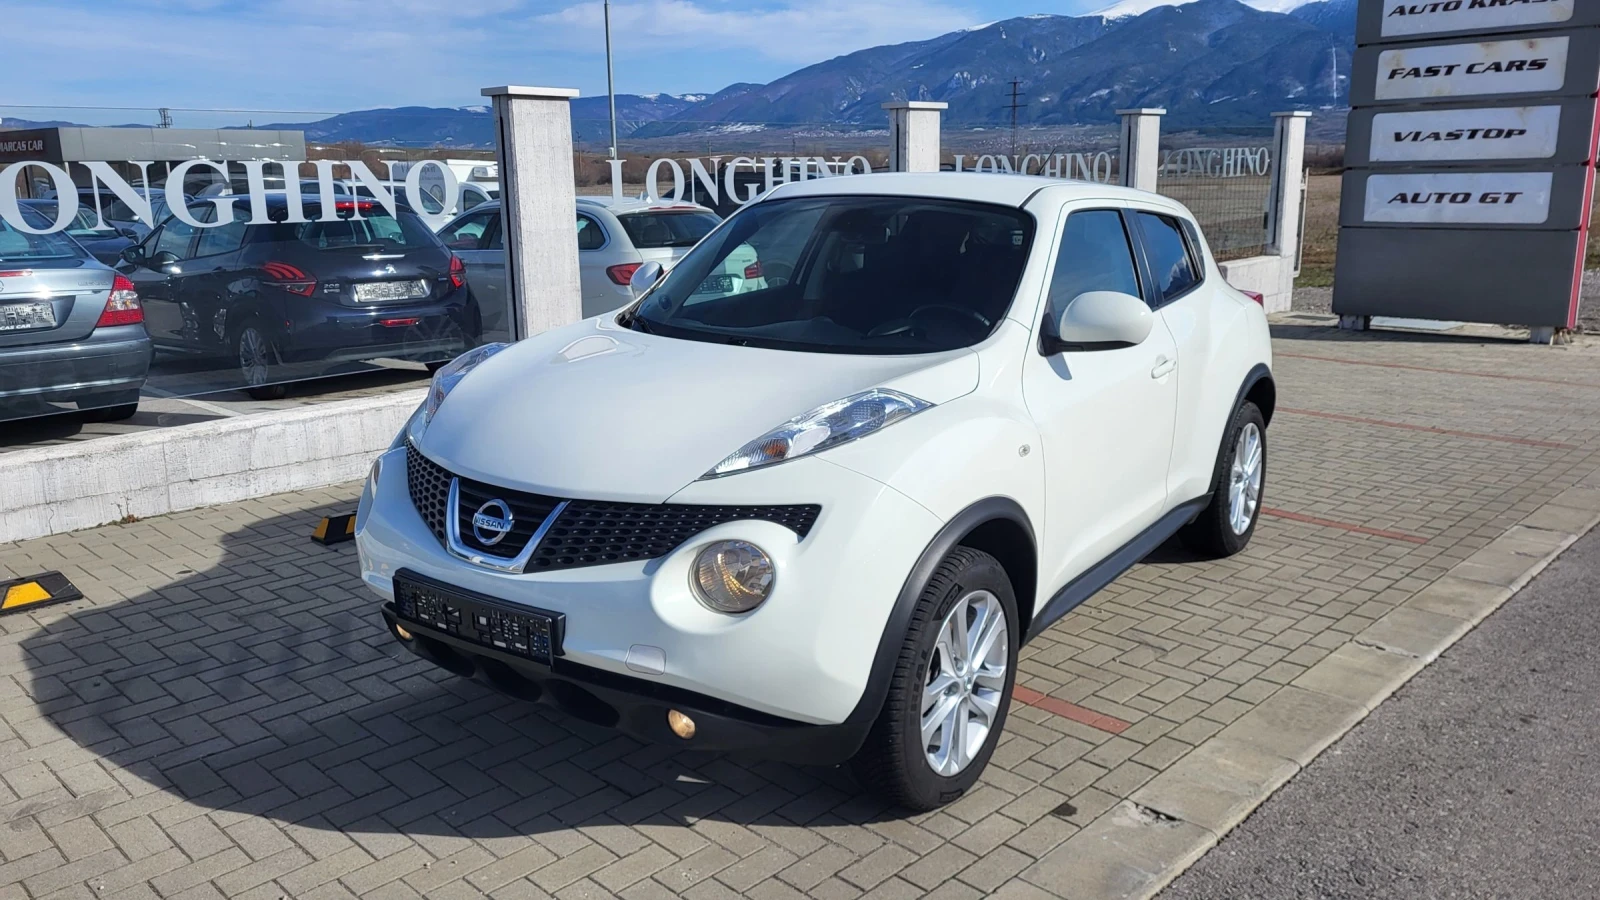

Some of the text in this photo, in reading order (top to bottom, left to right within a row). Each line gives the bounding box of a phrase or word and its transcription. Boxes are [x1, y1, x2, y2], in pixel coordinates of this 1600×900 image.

[1388, 1, 1463, 17] AUTO
[1387, 58, 1549, 80] FAST CARS
[1393, 128, 1527, 142] VIASTOP
[28, 140, 43, 151] CAR
[0, 160, 459, 235] ONGHINO
[1387, 192, 1523, 204] AUTO GT
[474, 515, 505, 530] NISSAN
